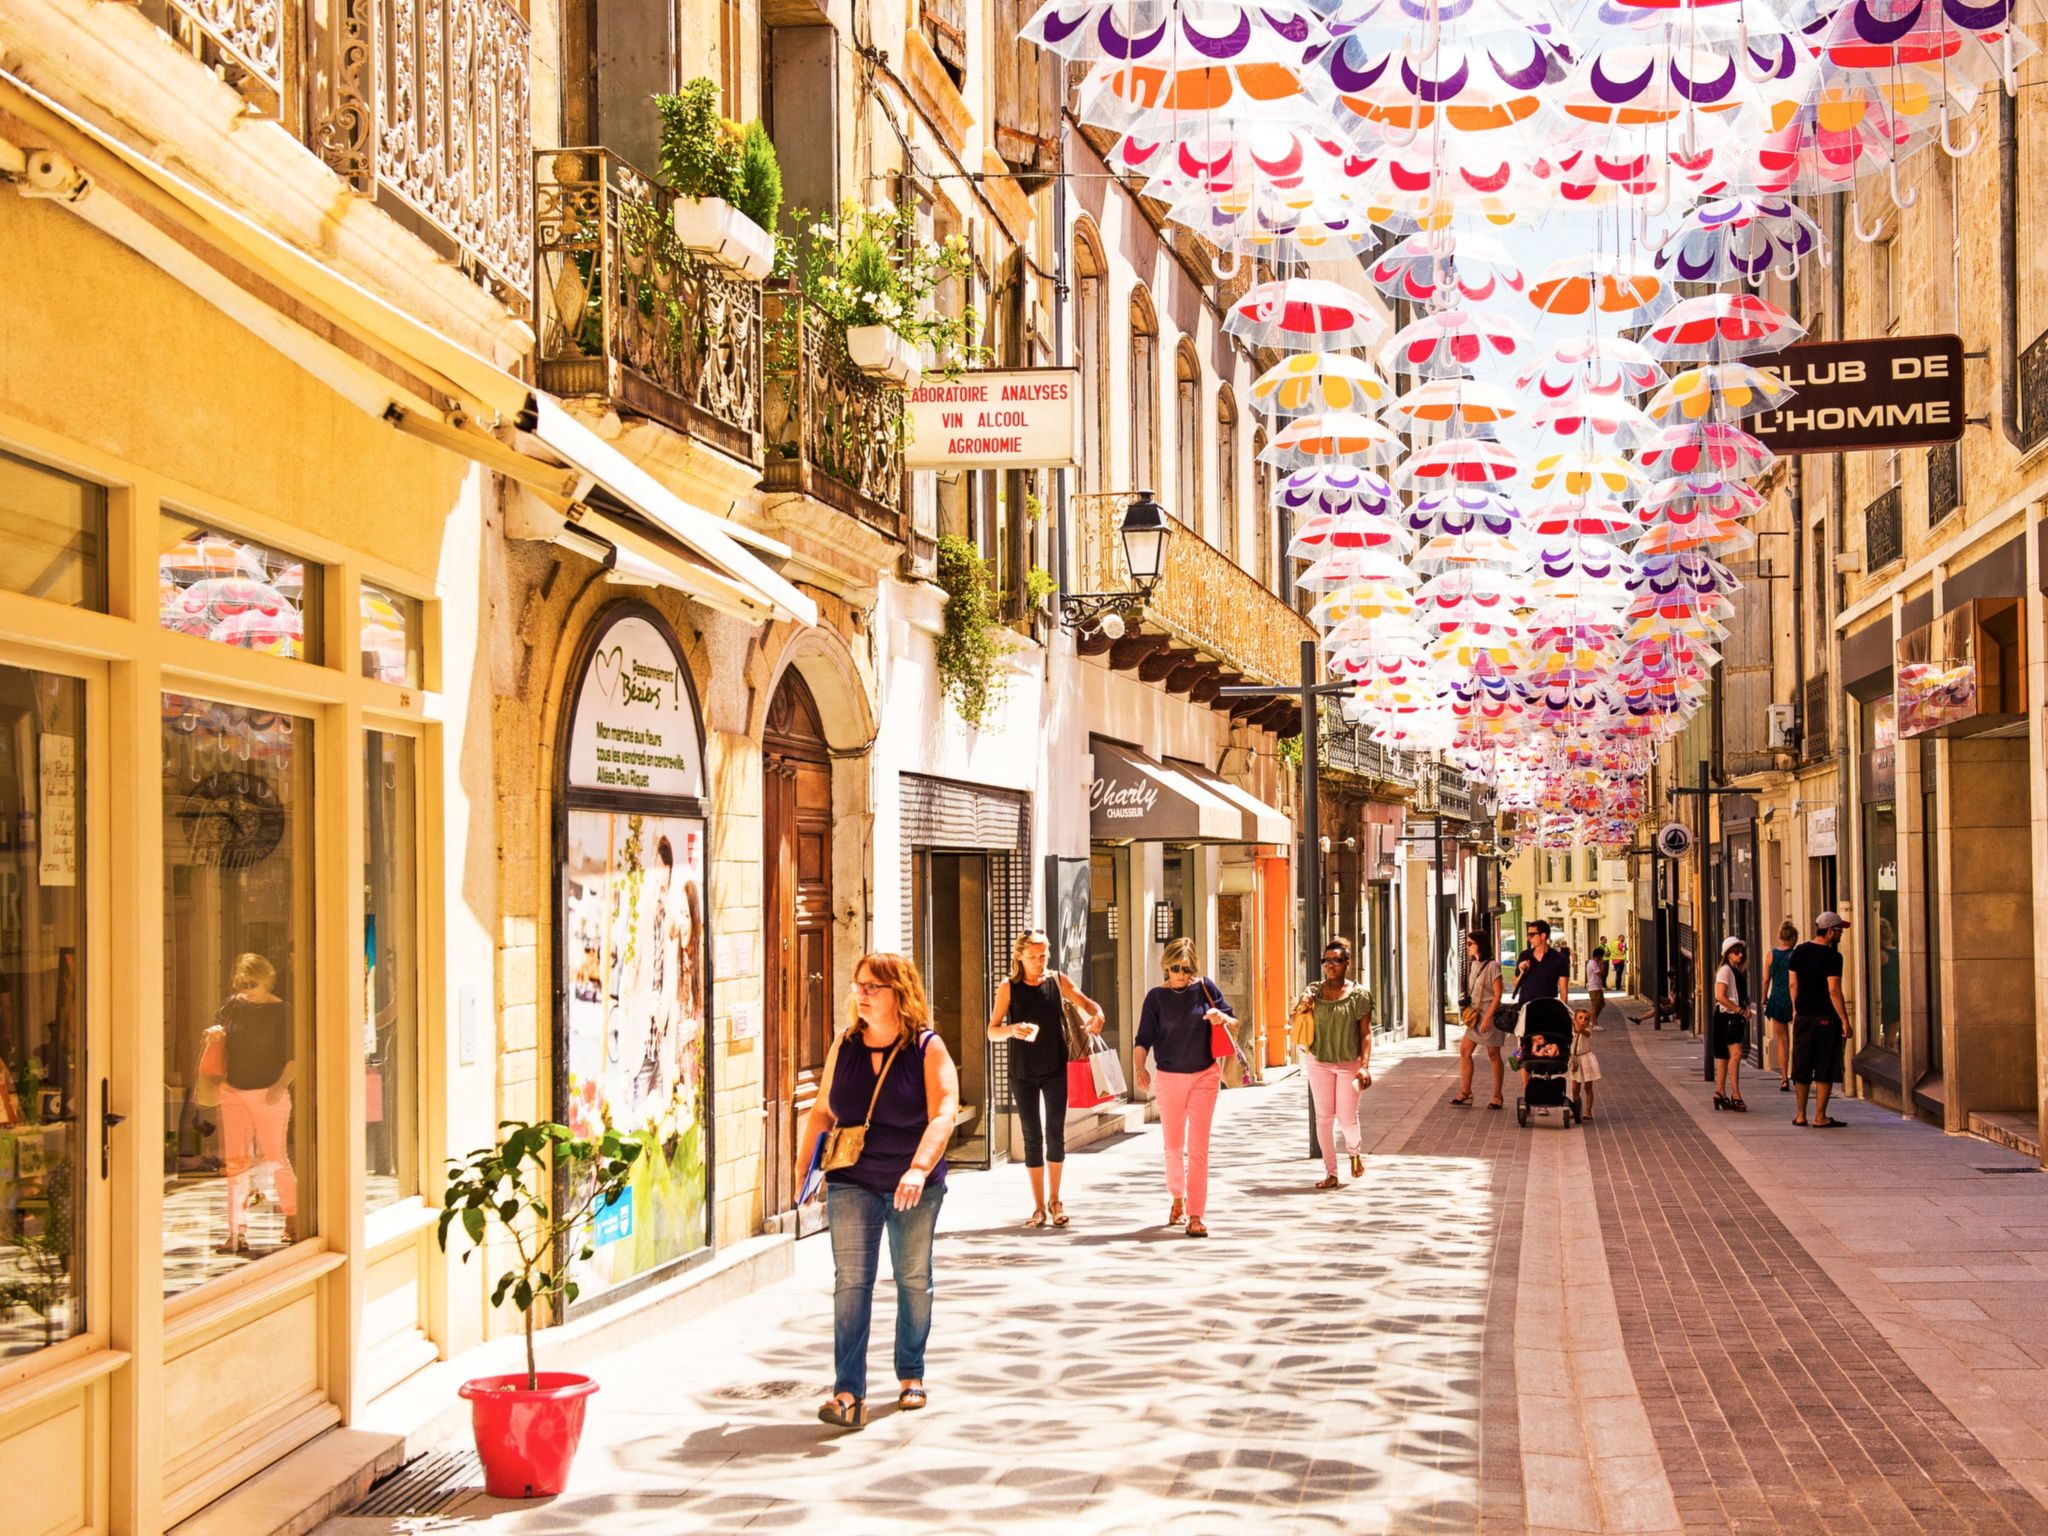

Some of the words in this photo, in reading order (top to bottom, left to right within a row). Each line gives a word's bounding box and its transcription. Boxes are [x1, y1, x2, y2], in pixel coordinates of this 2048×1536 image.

[1891, 355, 1949, 380] DE
[1001, 384, 1068, 402] ANALYSES
[942, 412, 963, 428] VIN
[977, 411, 1029, 428] ALCOOL
[1755, 401, 1951, 434] L'HOMME
[948, 437, 1022, 455] AGRONOMIE
[596, 721, 610, 740] Mon
[611, 725, 634, 743] marché
[616, 767, 630, 786] Paul
[1089, 777, 1158, 812] Charly
[1106, 807, 1144, 818] CHAUSSEUR
